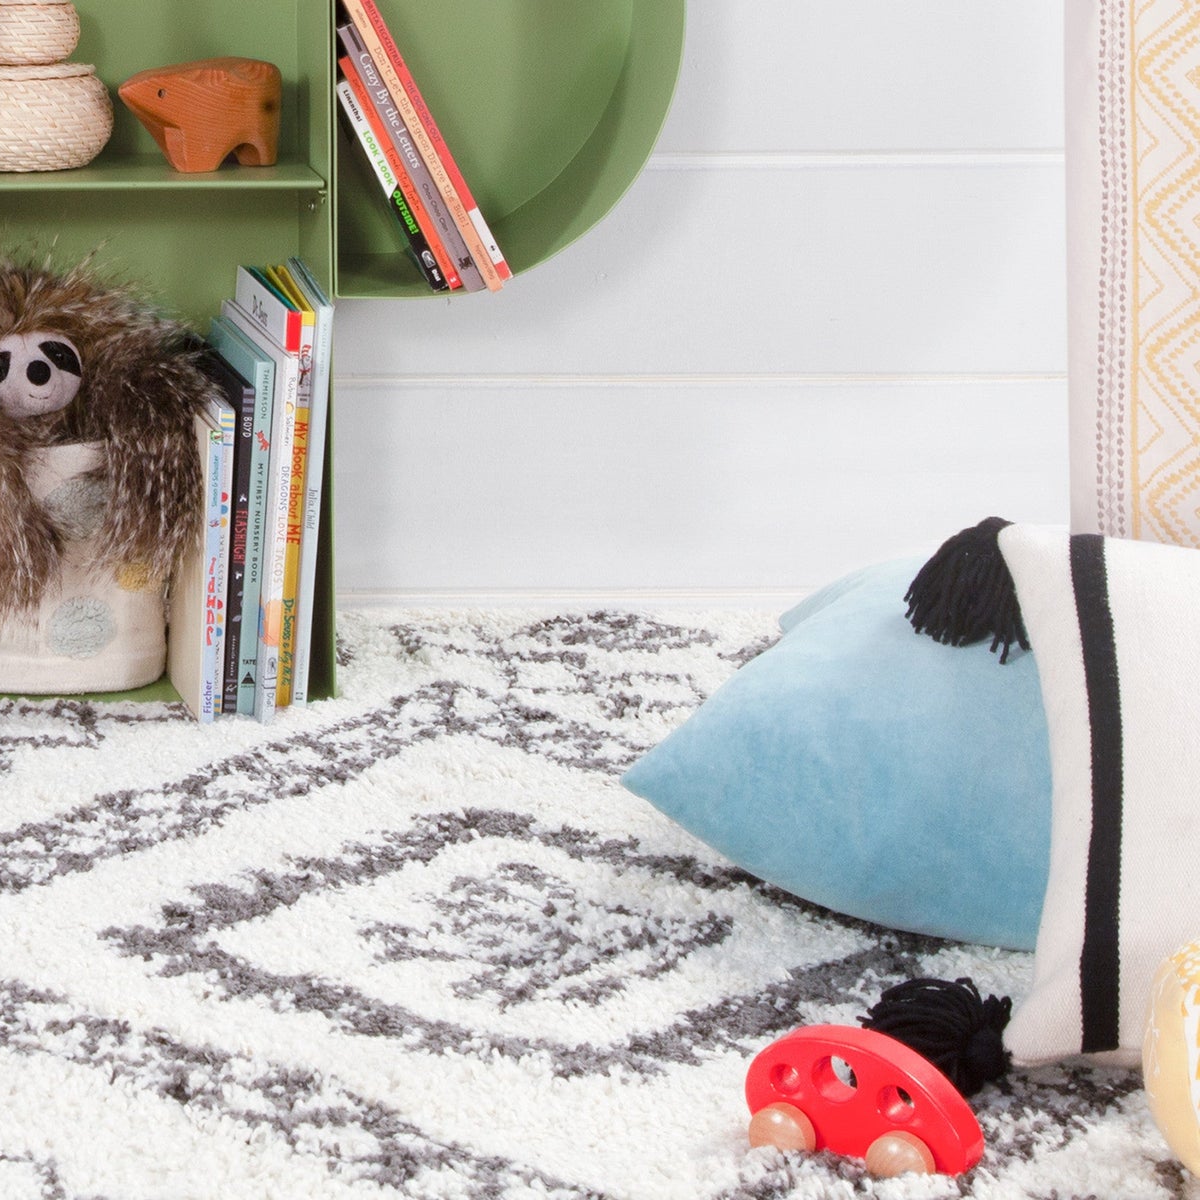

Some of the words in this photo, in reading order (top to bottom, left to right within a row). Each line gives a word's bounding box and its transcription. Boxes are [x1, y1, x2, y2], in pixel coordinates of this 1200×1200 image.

[365, 0, 380, 23] BRITTA
[355, 52, 384, 90] Crazy
[373, 88, 392, 108] By
[385, 106, 403, 128] the
[395, 127, 424, 170] Letters
[373, 46, 393, 76] Don't
[389, 77, 403, 95] Let
[399, 97, 413, 115] the
[408, 116, 432, 153] Pigeon
[427, 153, 448, 183] Drive
[442, 184, 456, 202] the
[429, 127, 441, 143] OUT
[363, 130, 380, 157] LOOK
[377, 160, 395, 187] LOOK
[392, 190, 419, 235] OUTSIDE!
[261, 369, 269, 420] THEMERSON
[242, 416, 252, 438] BOYD
[294, 422, 309, 441] MY
[257, 463, 263, 476] MY
[291, 446, 306, 480] Book
[279, 466, 290, 511] DRAGONS
[288, 484, 304, 520] about
[233, 510, 247, 565] FLASHLIGHT
[253, 511, 261, 552] NURSERY
[276, 517, 286, 544] LOVE
[287, 524, 301, 545] ME
[274, 547, 284, 584] TACOS
[282, 598, 295, 615] Dr.
[283, 616, 294, 641] Seuss
[202, 681, 212, 713] Fischer
